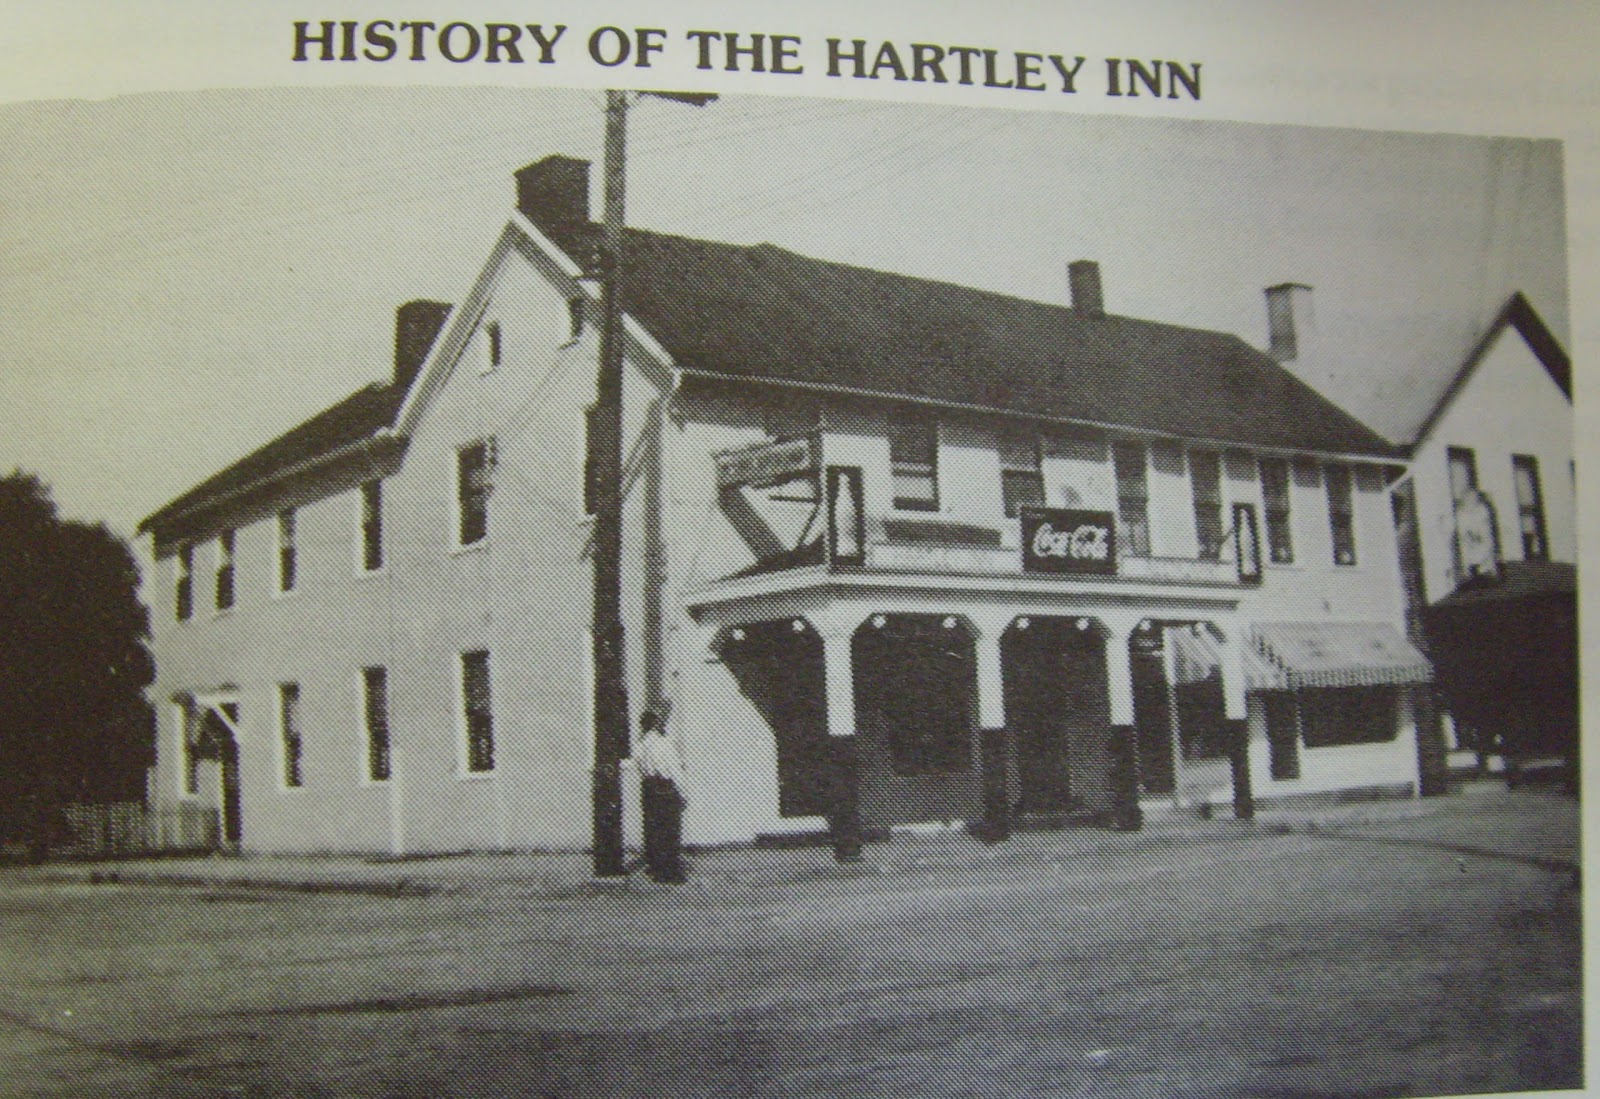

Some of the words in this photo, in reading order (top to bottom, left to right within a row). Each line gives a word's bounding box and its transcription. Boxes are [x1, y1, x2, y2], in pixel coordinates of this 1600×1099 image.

[292, 20, 567, 64] HISTORY
[588, 26, 667, 68] OF
[686, 31, 803, 75] THE
[826, 38, 1085, 94] HARTLEY
[1105, 58, 1201, 101] INN
